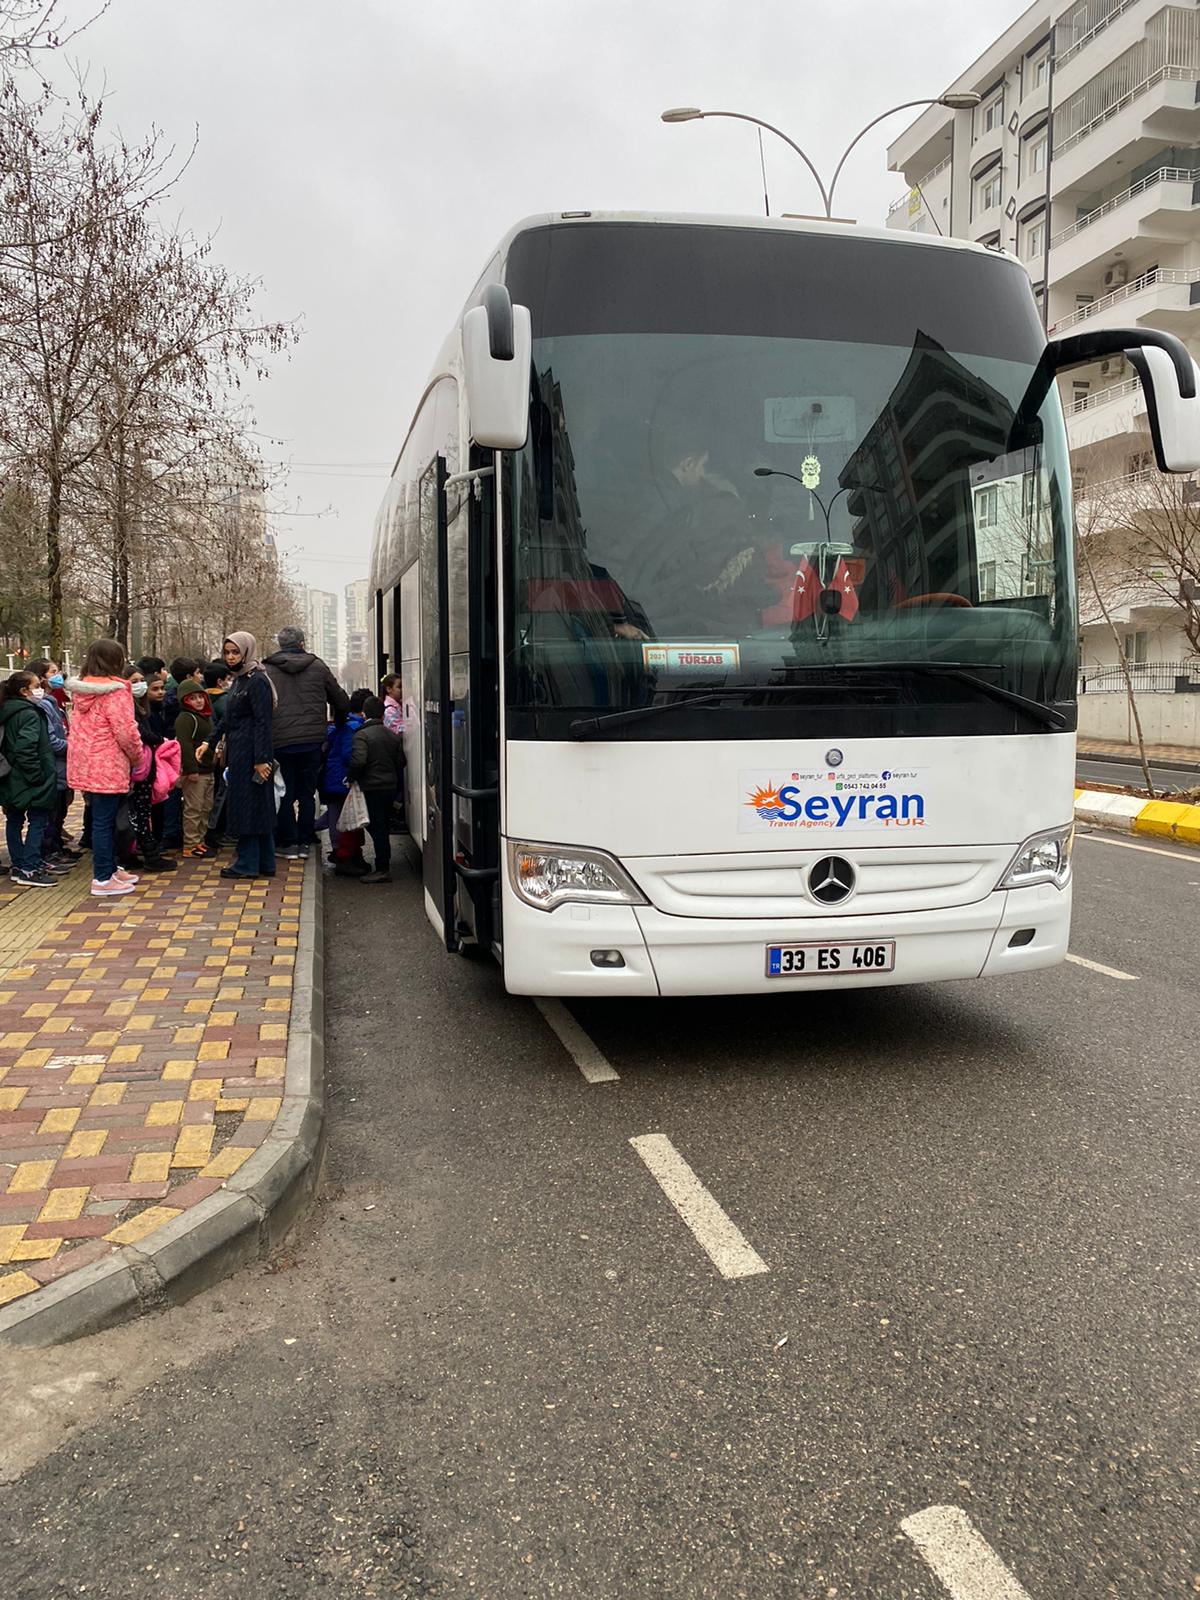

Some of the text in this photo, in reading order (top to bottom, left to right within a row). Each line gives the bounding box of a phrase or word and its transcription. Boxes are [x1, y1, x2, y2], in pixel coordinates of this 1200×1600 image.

[678, 653, 723, 665] TÜRSAB
[778, 786, 924, 827] Seyran
[768, 820, 836, 828] Travel Agency
[883, 819, 926, 827] TUR
[782, 946, 886, 972] 33 ES 406
